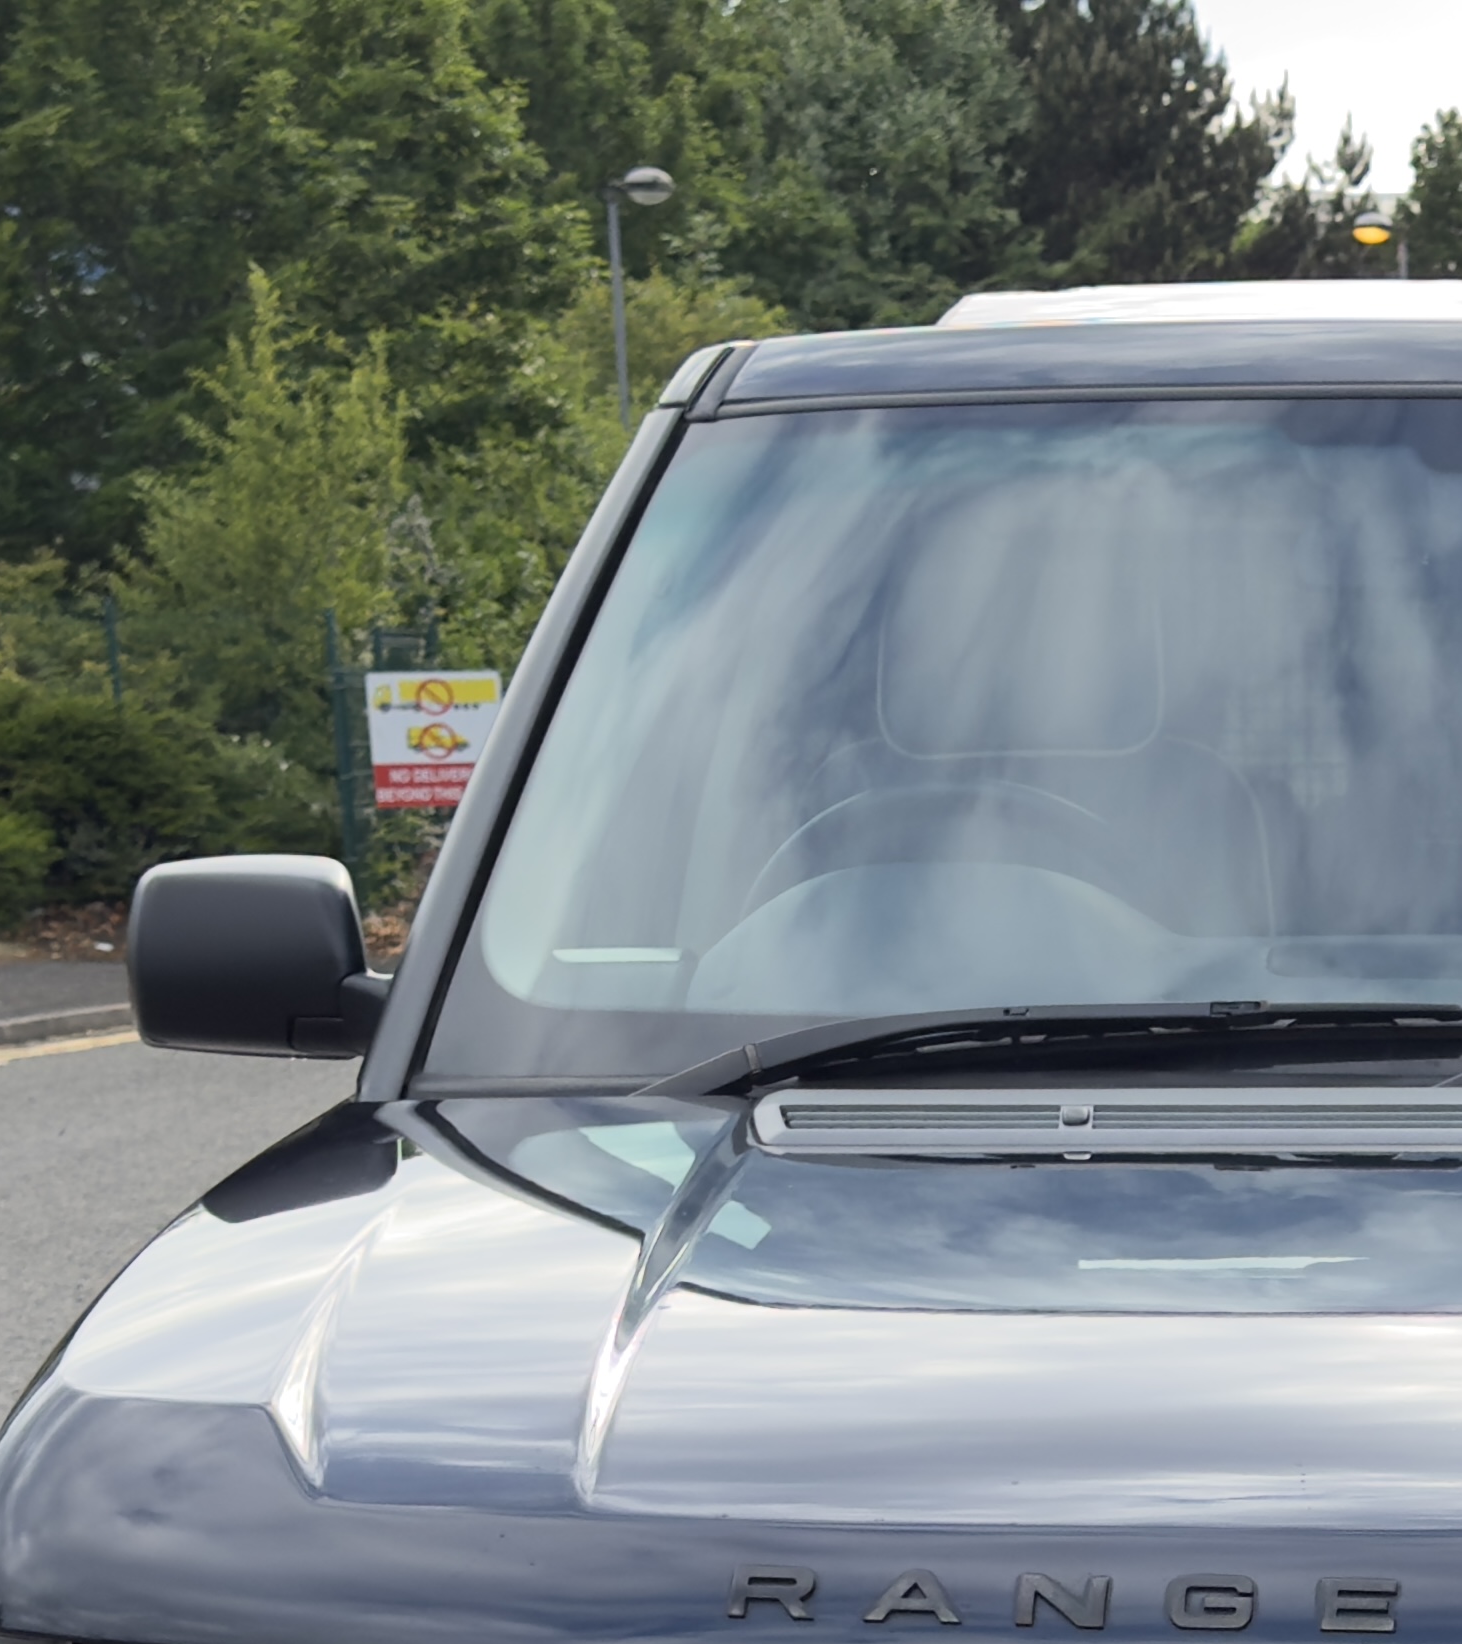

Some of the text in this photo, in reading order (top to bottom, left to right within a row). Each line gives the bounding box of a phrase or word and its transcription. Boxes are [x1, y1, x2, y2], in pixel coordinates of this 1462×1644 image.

[388, 765, 476, 784] NO DELIVER
[375, 787, 433, 803] BEYOND
[728, 1563, 1403, 1633] RANGE
